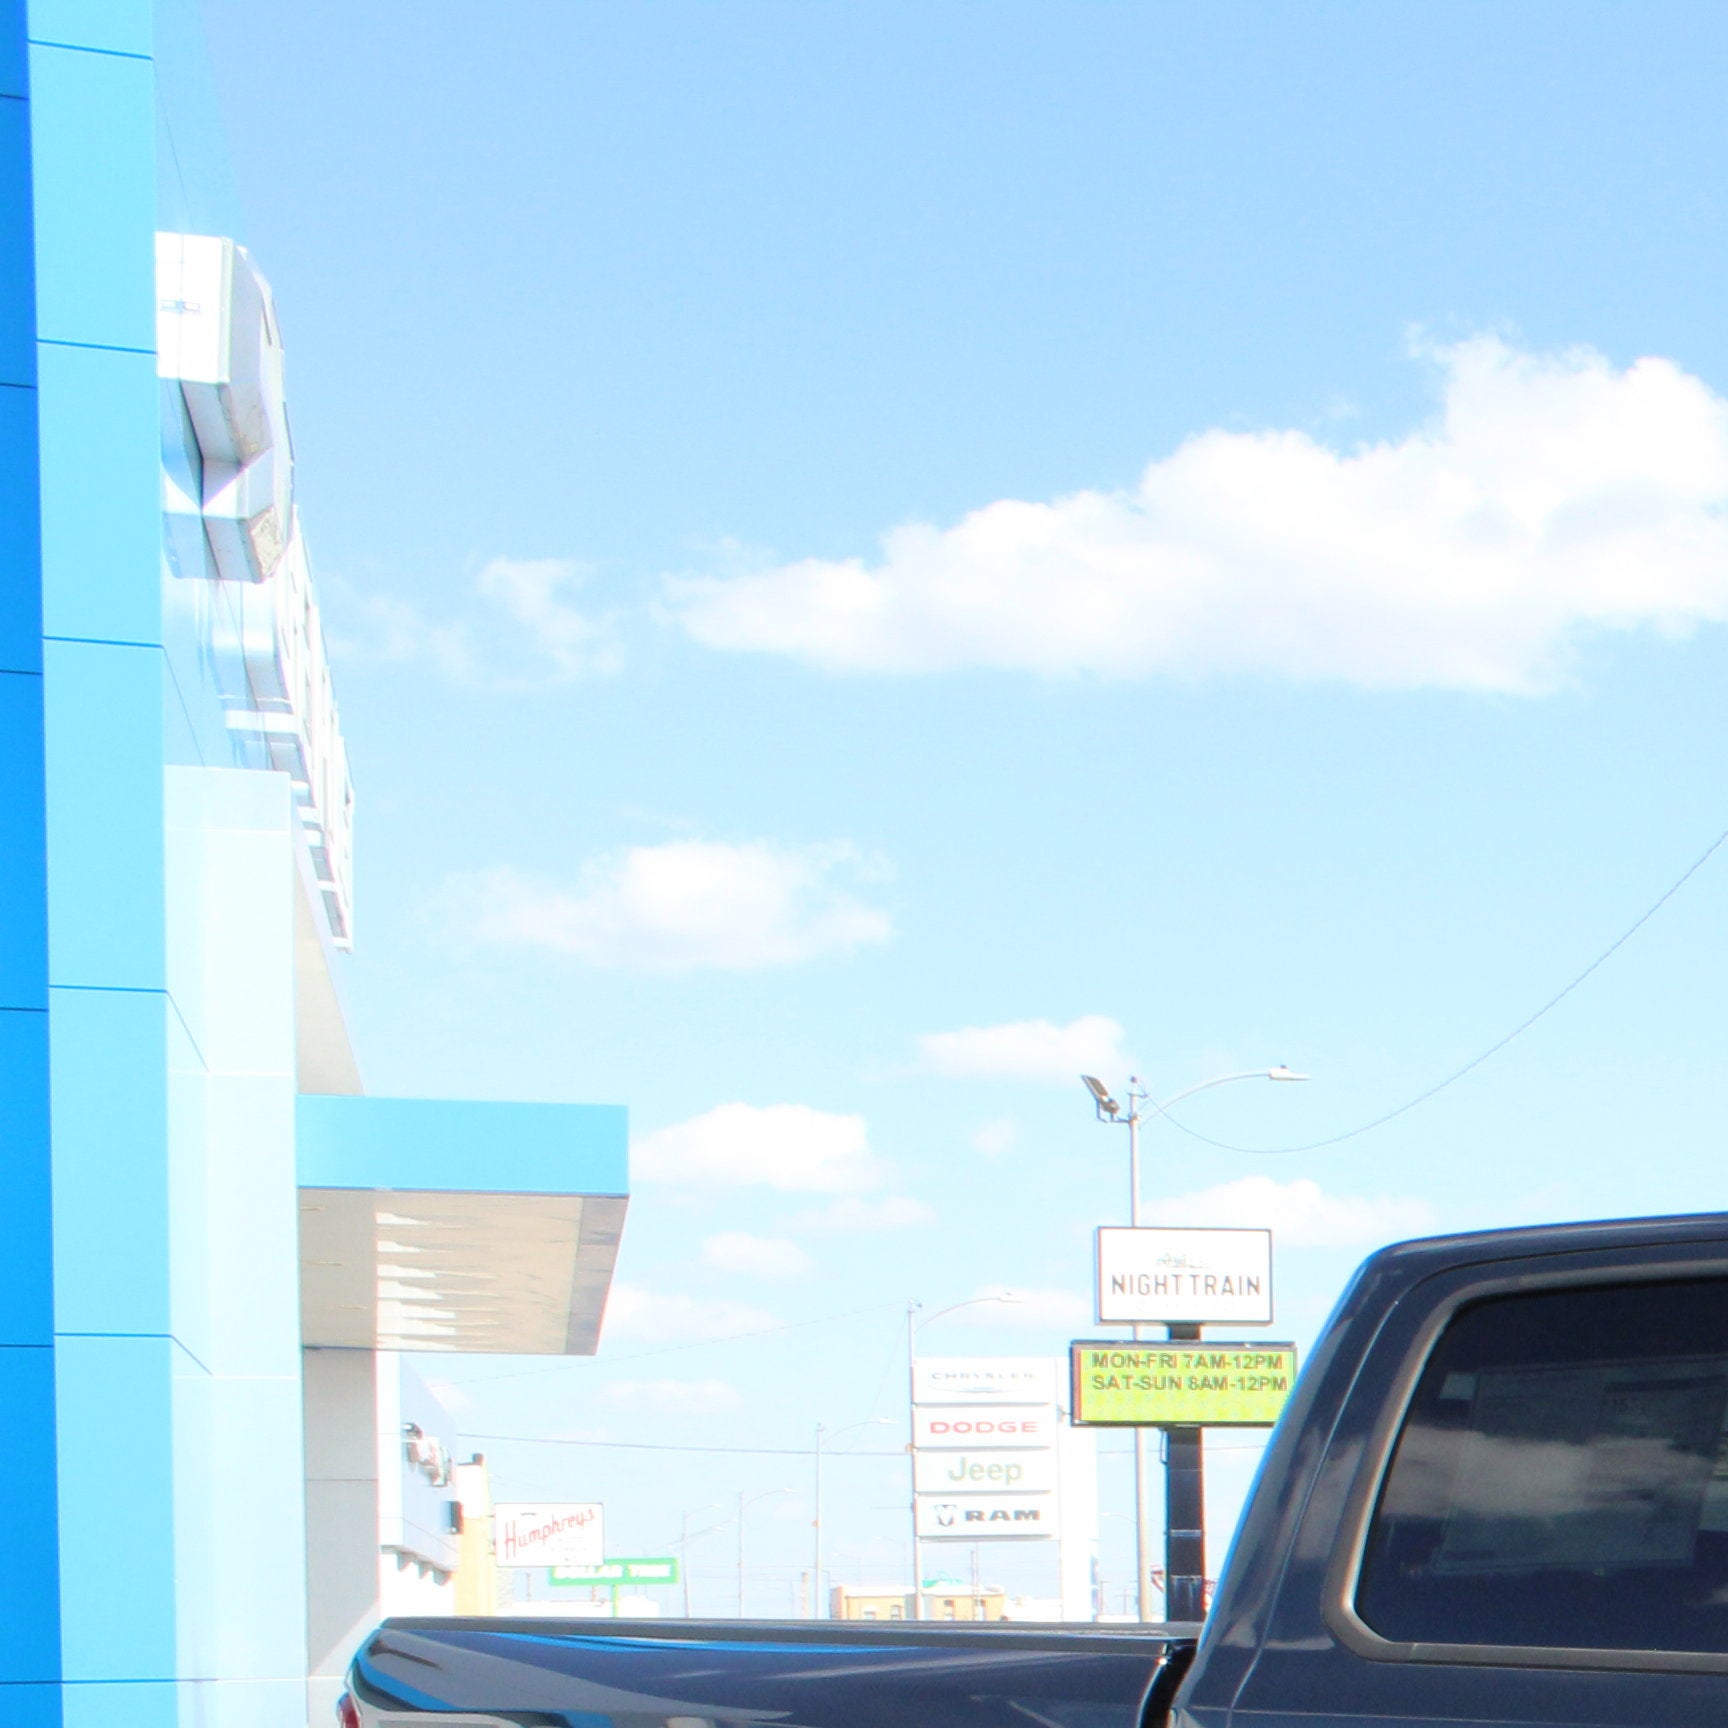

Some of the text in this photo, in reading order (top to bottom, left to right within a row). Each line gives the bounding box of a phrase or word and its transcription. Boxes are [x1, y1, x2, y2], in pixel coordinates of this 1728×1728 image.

[1112, 1273, 1260, 1297] NIGHT TRAIN
[1092, 1353, 1283, 1370] MON-FRI 7AM-12PM
[931, 1372, 1034, 1380] CHRYSLER
[1092, 1375, 1288, 1391] SAT-SUN 8AM-12PM
[930, 1421, 1038, 1434] DODGE
[948, 1456, 1022, 1485] Jeep
[965, 1509, 1041, 1521] RAM
[504, 1508, 594, 1560] Humphreys
